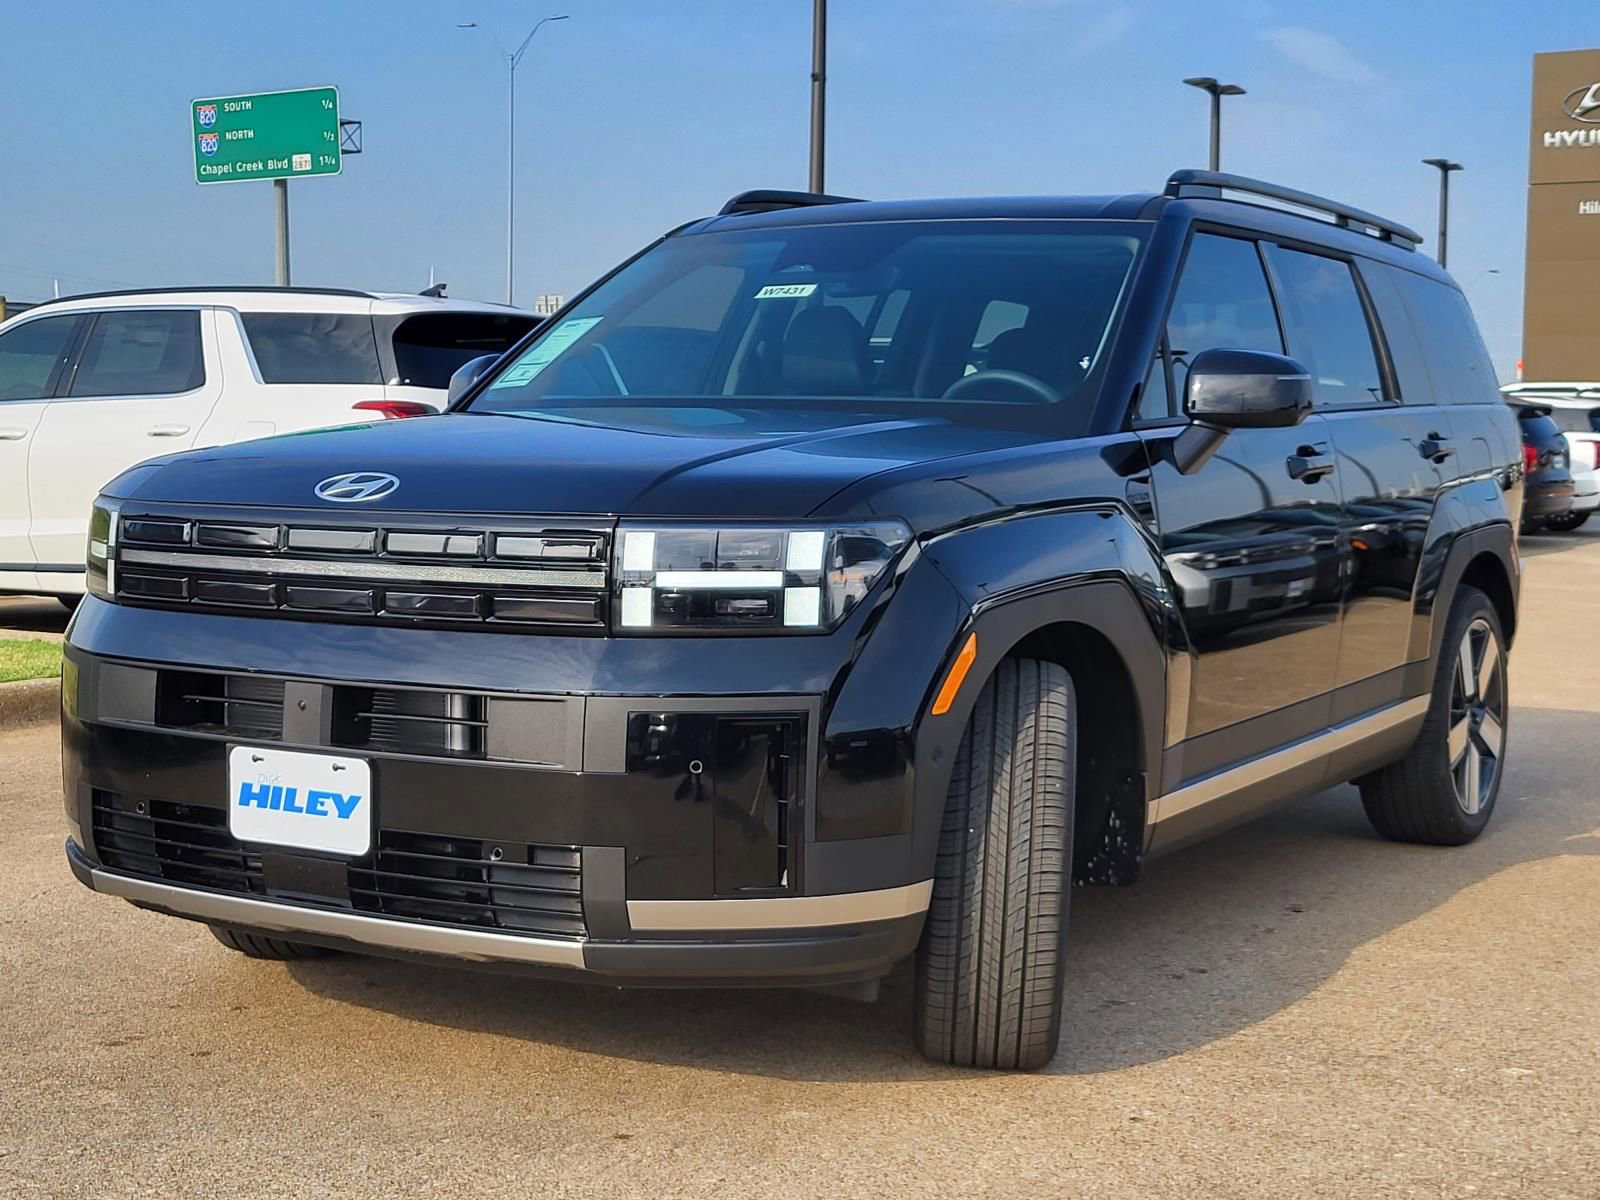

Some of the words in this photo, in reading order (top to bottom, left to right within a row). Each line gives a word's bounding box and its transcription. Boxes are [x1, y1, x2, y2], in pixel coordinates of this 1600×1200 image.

[200, 110, 216, 124] 820
[224, 101, 252, 112] SOUTH
[201, 139, 218, 152] 820
[225, 129, 254, 140] NORTH
[1543, 129, 1600, 148] HYU
[200, 163, 233, 175] Chapel
[236, 161, 264, 172] Creek
[267, 158, 289, 170] Blvd
[1579, 200, 1600, 214] Hil
[238, 782, 362, 819] HILEY
